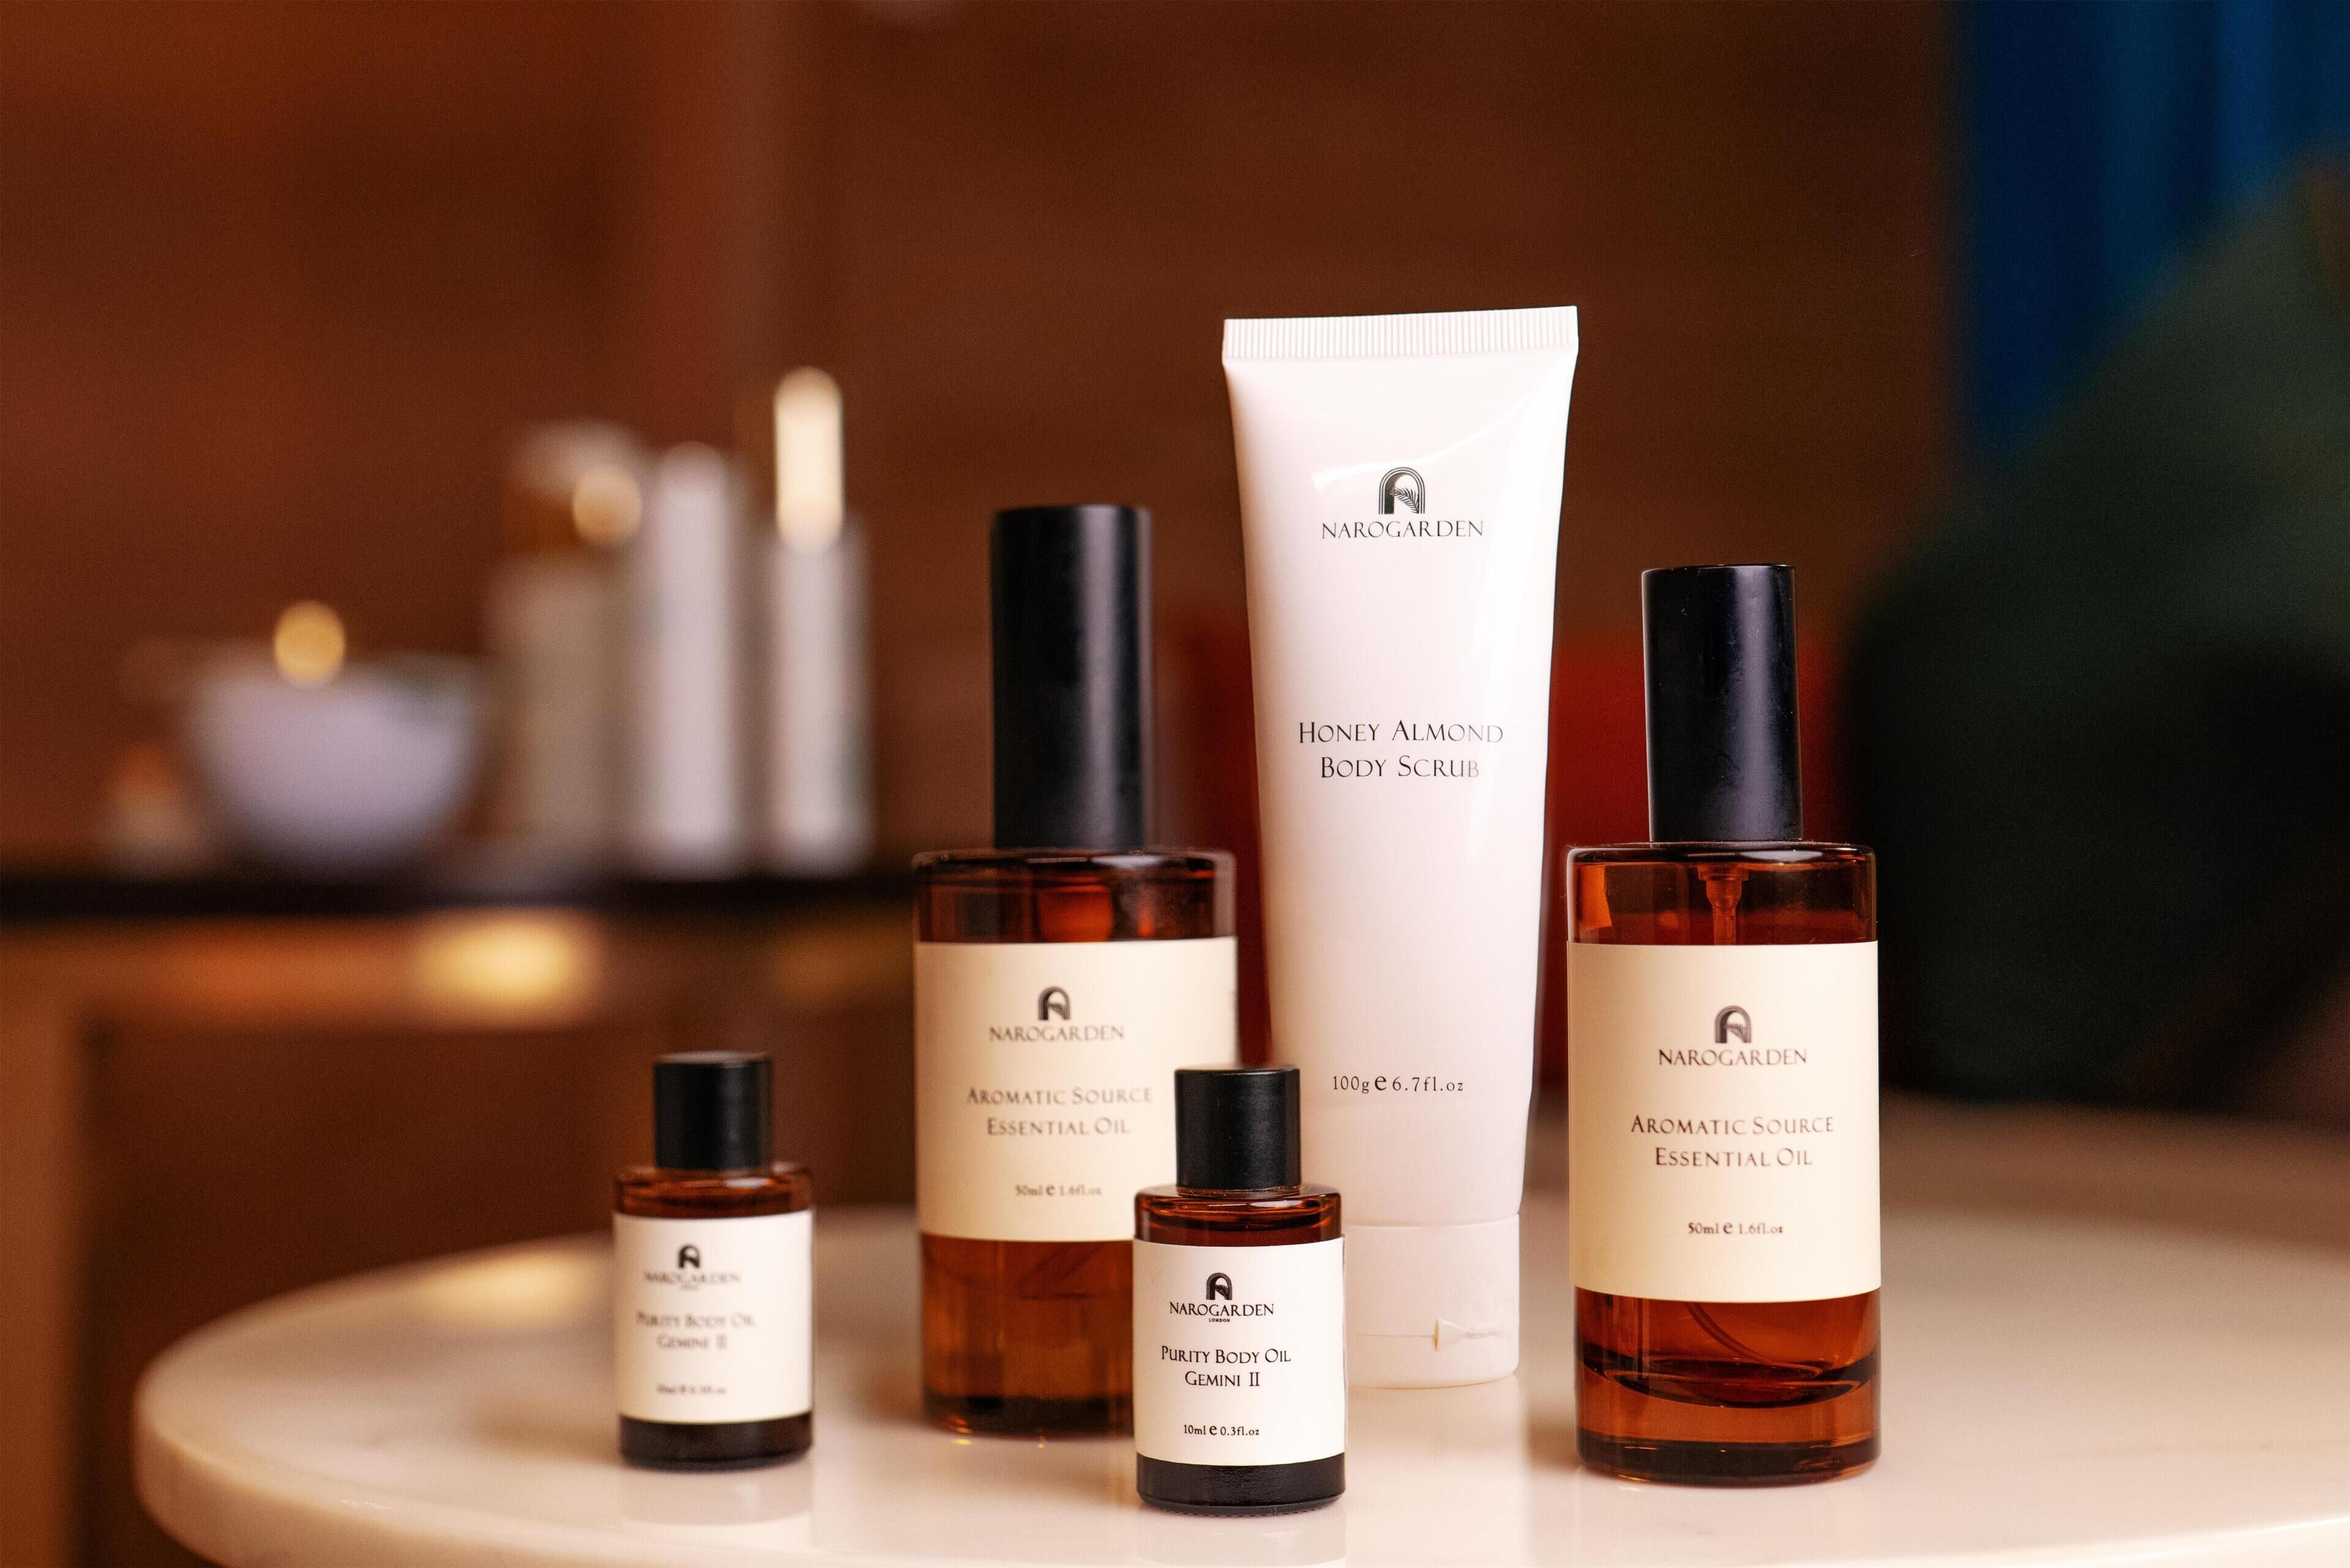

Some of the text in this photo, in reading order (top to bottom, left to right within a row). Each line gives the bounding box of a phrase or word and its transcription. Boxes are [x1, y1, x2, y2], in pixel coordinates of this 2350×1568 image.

[1322, 520, 1483, 539] NAROGARDEN
[1299, 720, 1503, 744] HONEY ALMOND
[1321, 755, 1479, 778] BODY SCRUB
[989, 1025, 1125, 1041] NAROGARDEN
[1658, 1049, 1807, 1066] NAROGARDEN
[1332, 1075, 1370, 1094] 100g
[1392, 1077, 1463, 1091] 6.7fl.oz
[966, 1086, 1152, 1106] AROMATIC SOURCE
[987, 1116, 1130, 1137] ESSENTIAL OIL
[1631, 1114, 1834, 1135] AROMATIC SOURCE
[1655, 1147, 1813, 1167] ESSENTIAL OIL
[1688, 1222, 1719, 1234] 50ml
[1169, 1302, 1274, 1316] NAROGARDEN
[1162, 1345, 1291, 1364] PURITY BODY OIL
[1185, 1371, 1261, 1387] GEMINI II
[1184, 1424, 1206, 1435] 10ml
[1220, 1426, 1259, 1436] 0.3fl.oz
